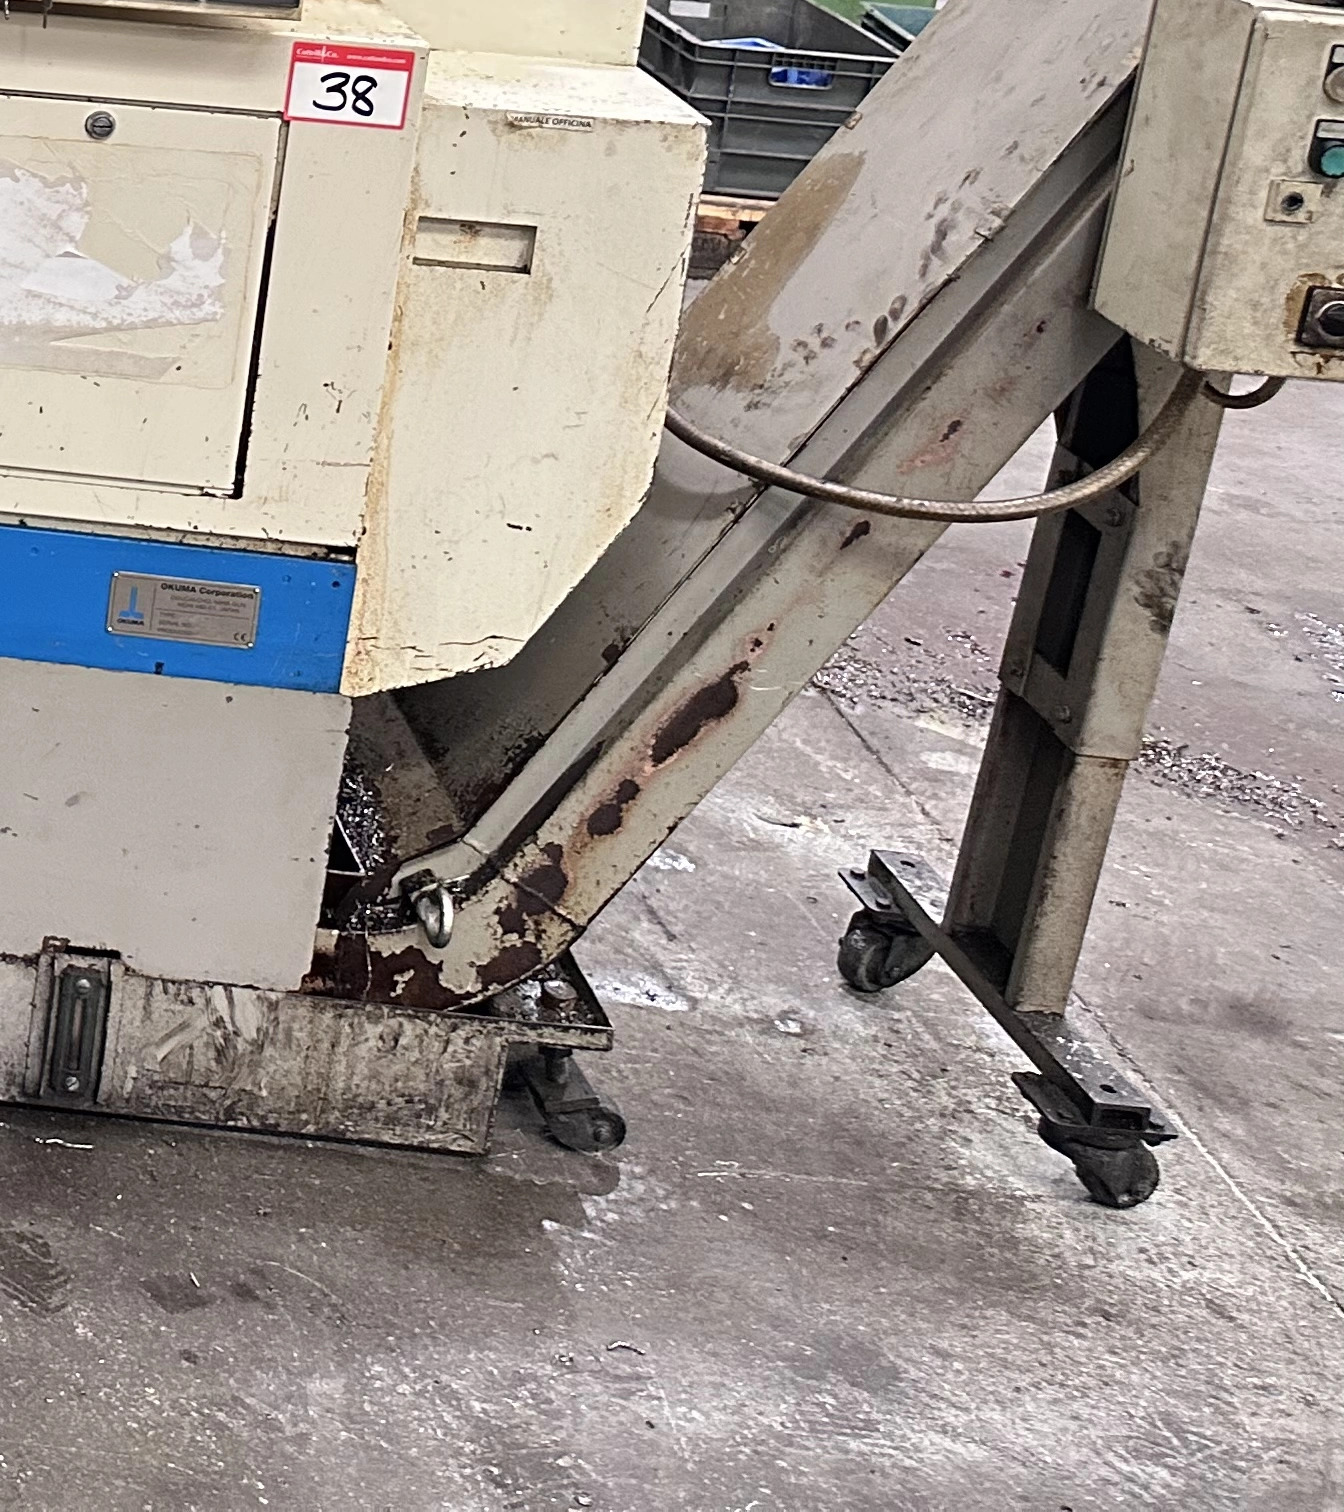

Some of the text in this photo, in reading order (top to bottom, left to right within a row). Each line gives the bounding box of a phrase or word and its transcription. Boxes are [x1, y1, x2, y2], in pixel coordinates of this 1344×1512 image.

[313, 71, 378, 117] 38
[160, 582, 254, 600] OKUMA Corporation
